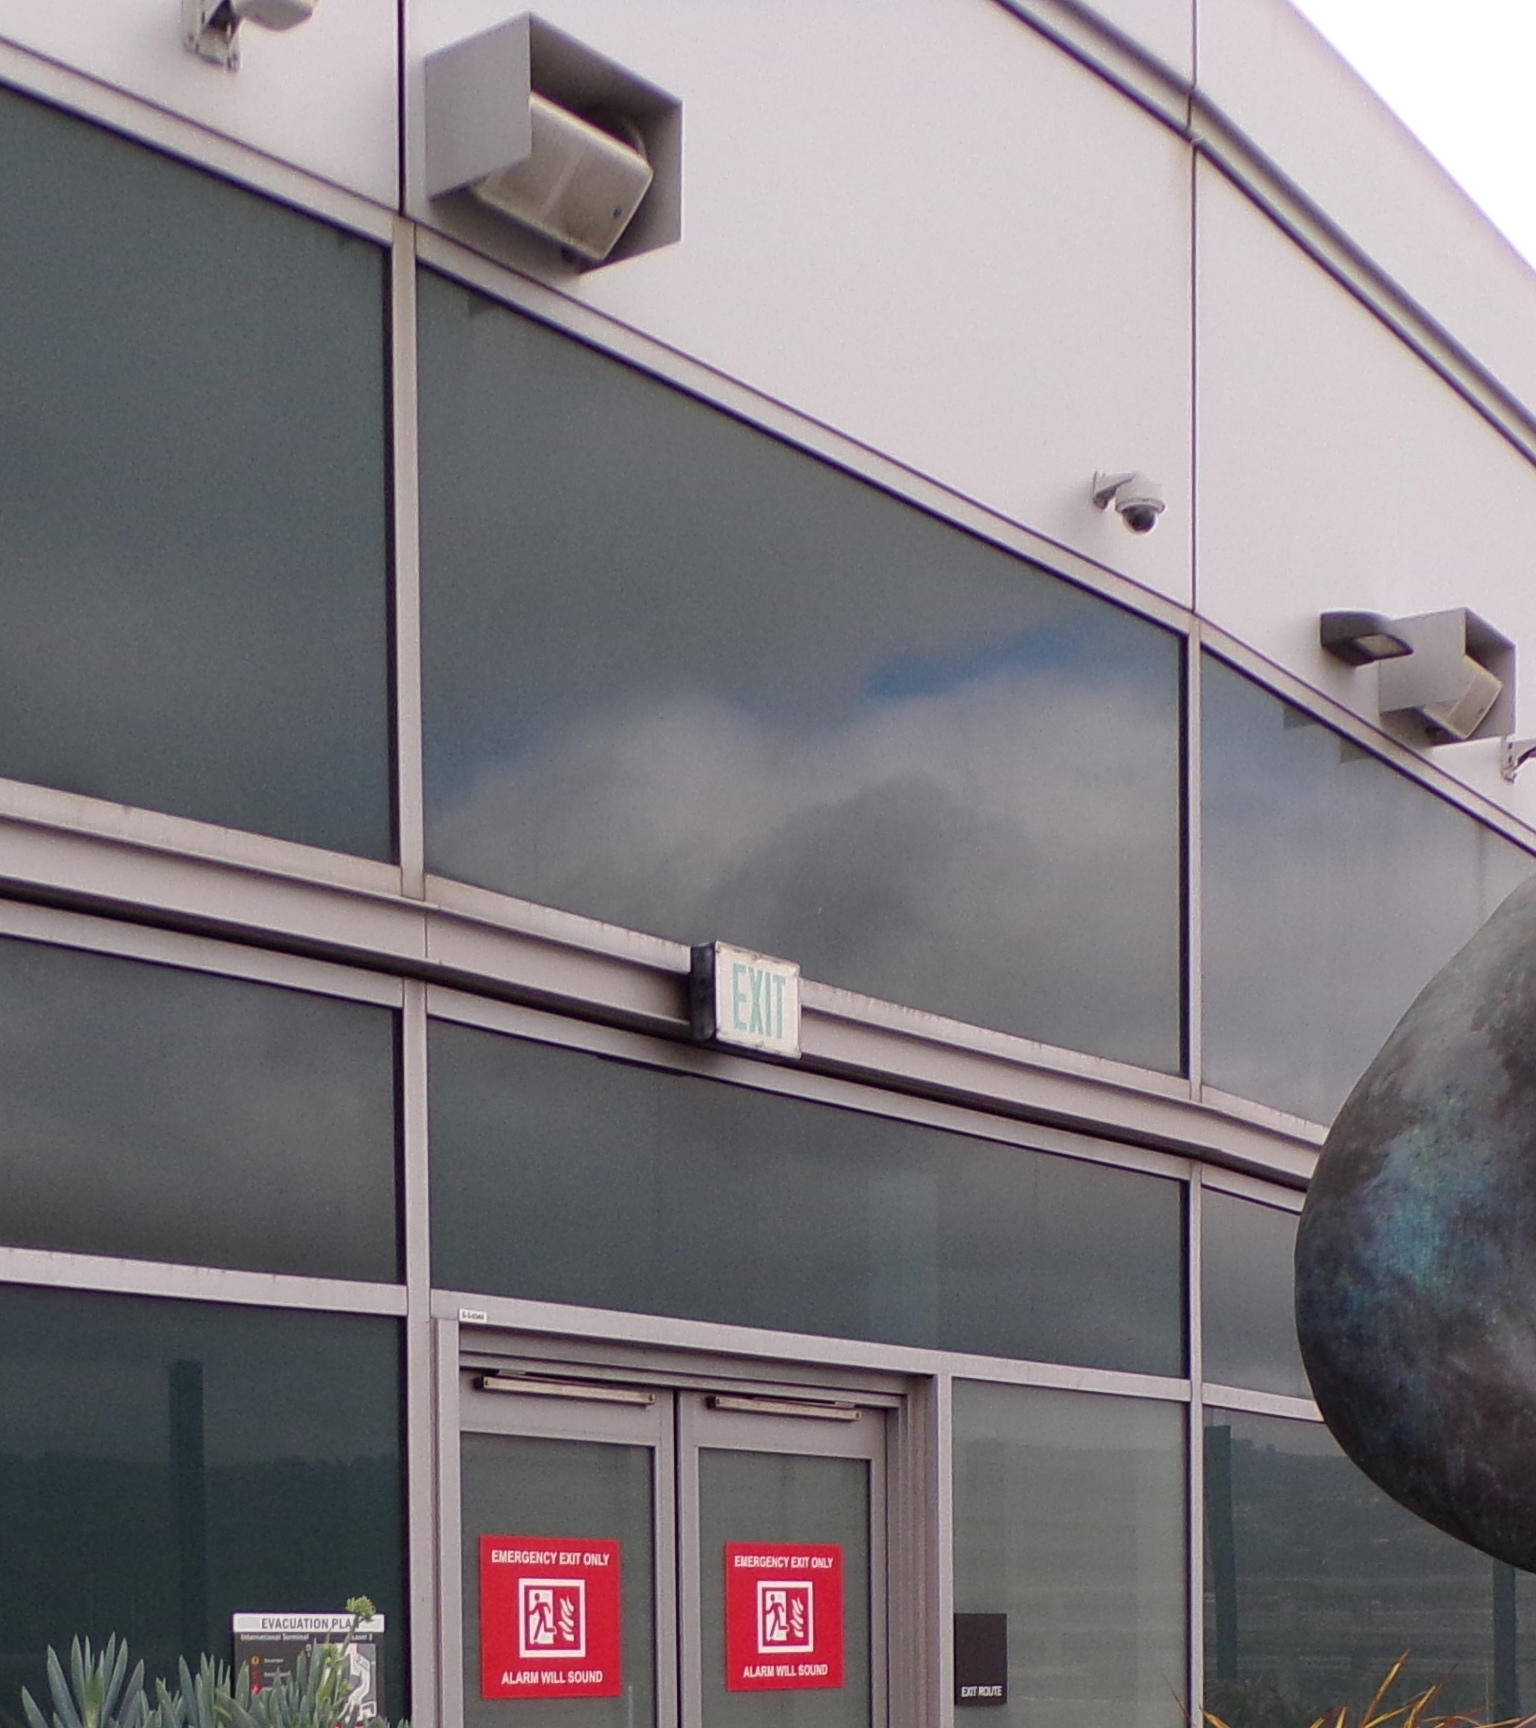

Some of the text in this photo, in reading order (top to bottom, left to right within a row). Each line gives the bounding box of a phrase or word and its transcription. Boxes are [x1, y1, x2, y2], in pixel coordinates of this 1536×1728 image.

[732, 962, 787, 1040] EXIT
[491, 1549, 610, 1566] EMERGENCY EXIT ONLY
[734, 1555, 834, 1569] EMERGENCY EXIT ONLY
[261, 1618, 329, 1630] EVACUATION
[501, 1670, 603, 1685] ALARM WILL SOUND
[743, 1663, 828, 1678] ALARM WILL SOUND
[960, 1685, 1003, 1698] EXIT ROUTE
